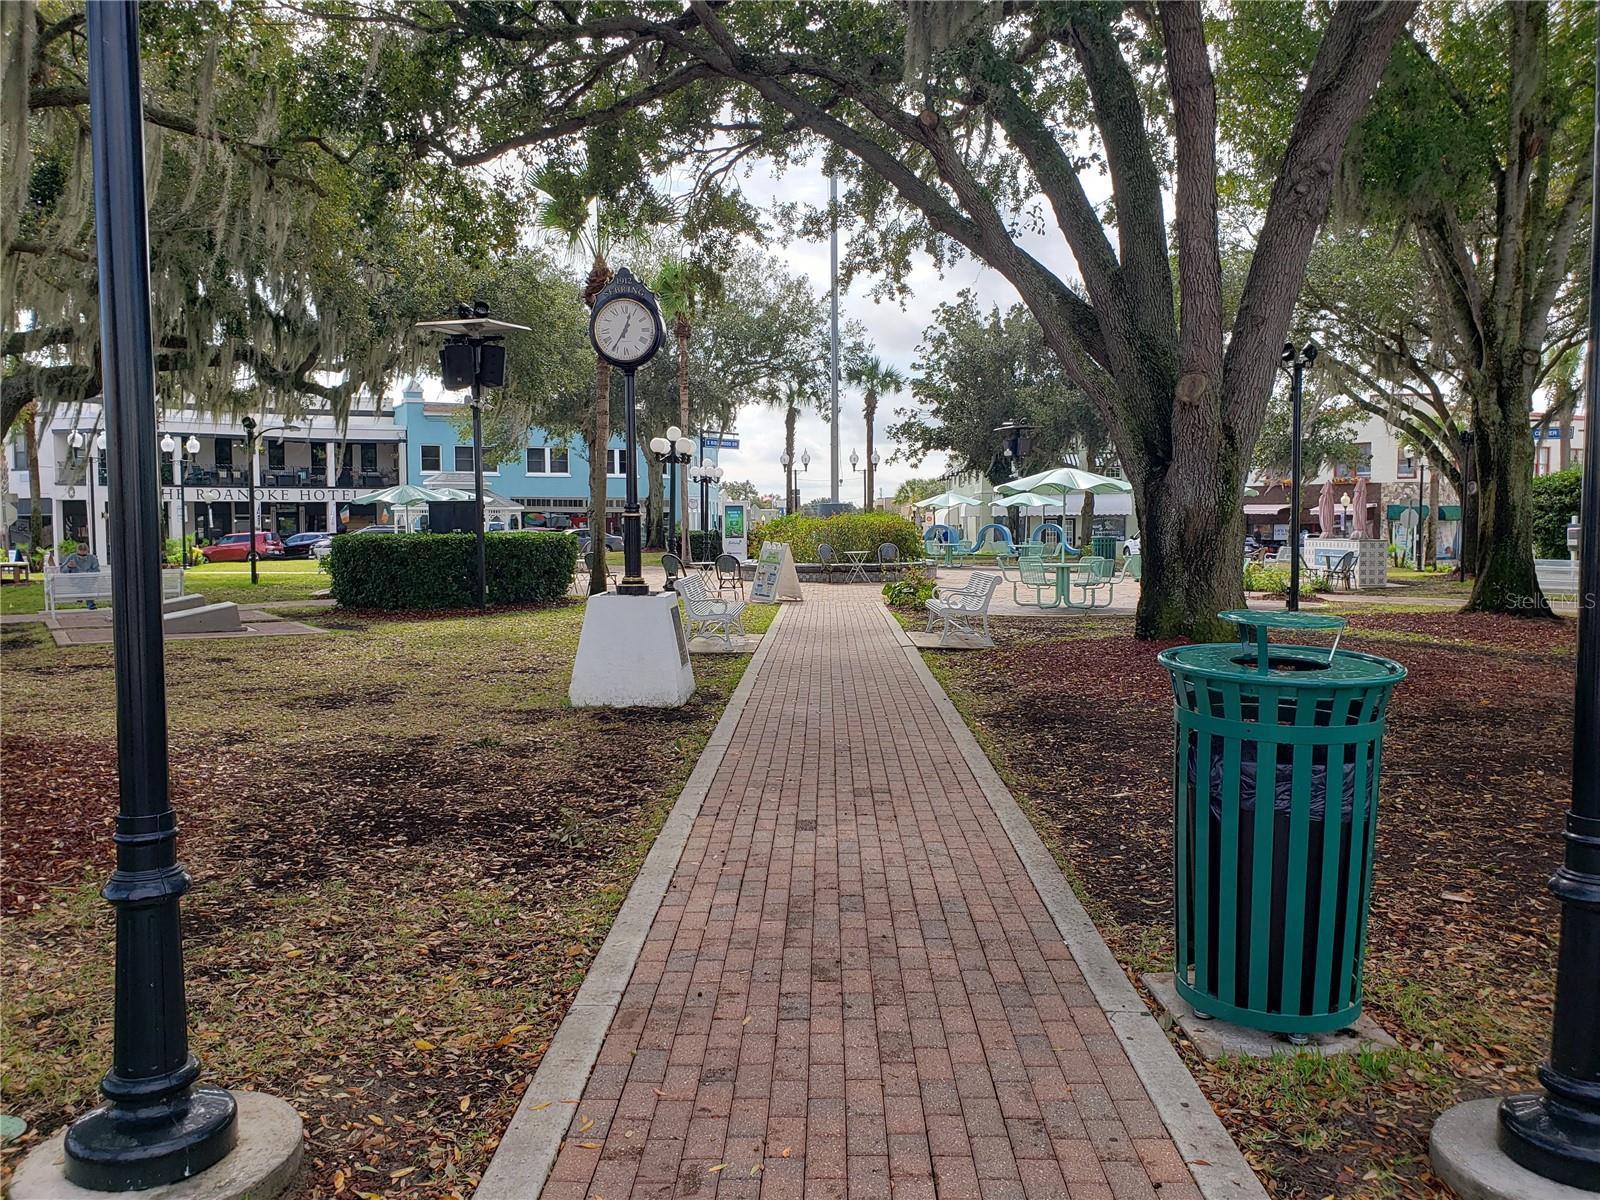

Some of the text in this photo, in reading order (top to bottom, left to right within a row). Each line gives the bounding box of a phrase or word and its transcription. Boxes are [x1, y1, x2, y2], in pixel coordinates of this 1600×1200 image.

[616, 277, 633, 285] 1912
[196, 488, 290, 501] ROANOKE
[300, 488, 358, 501] HOTEL
